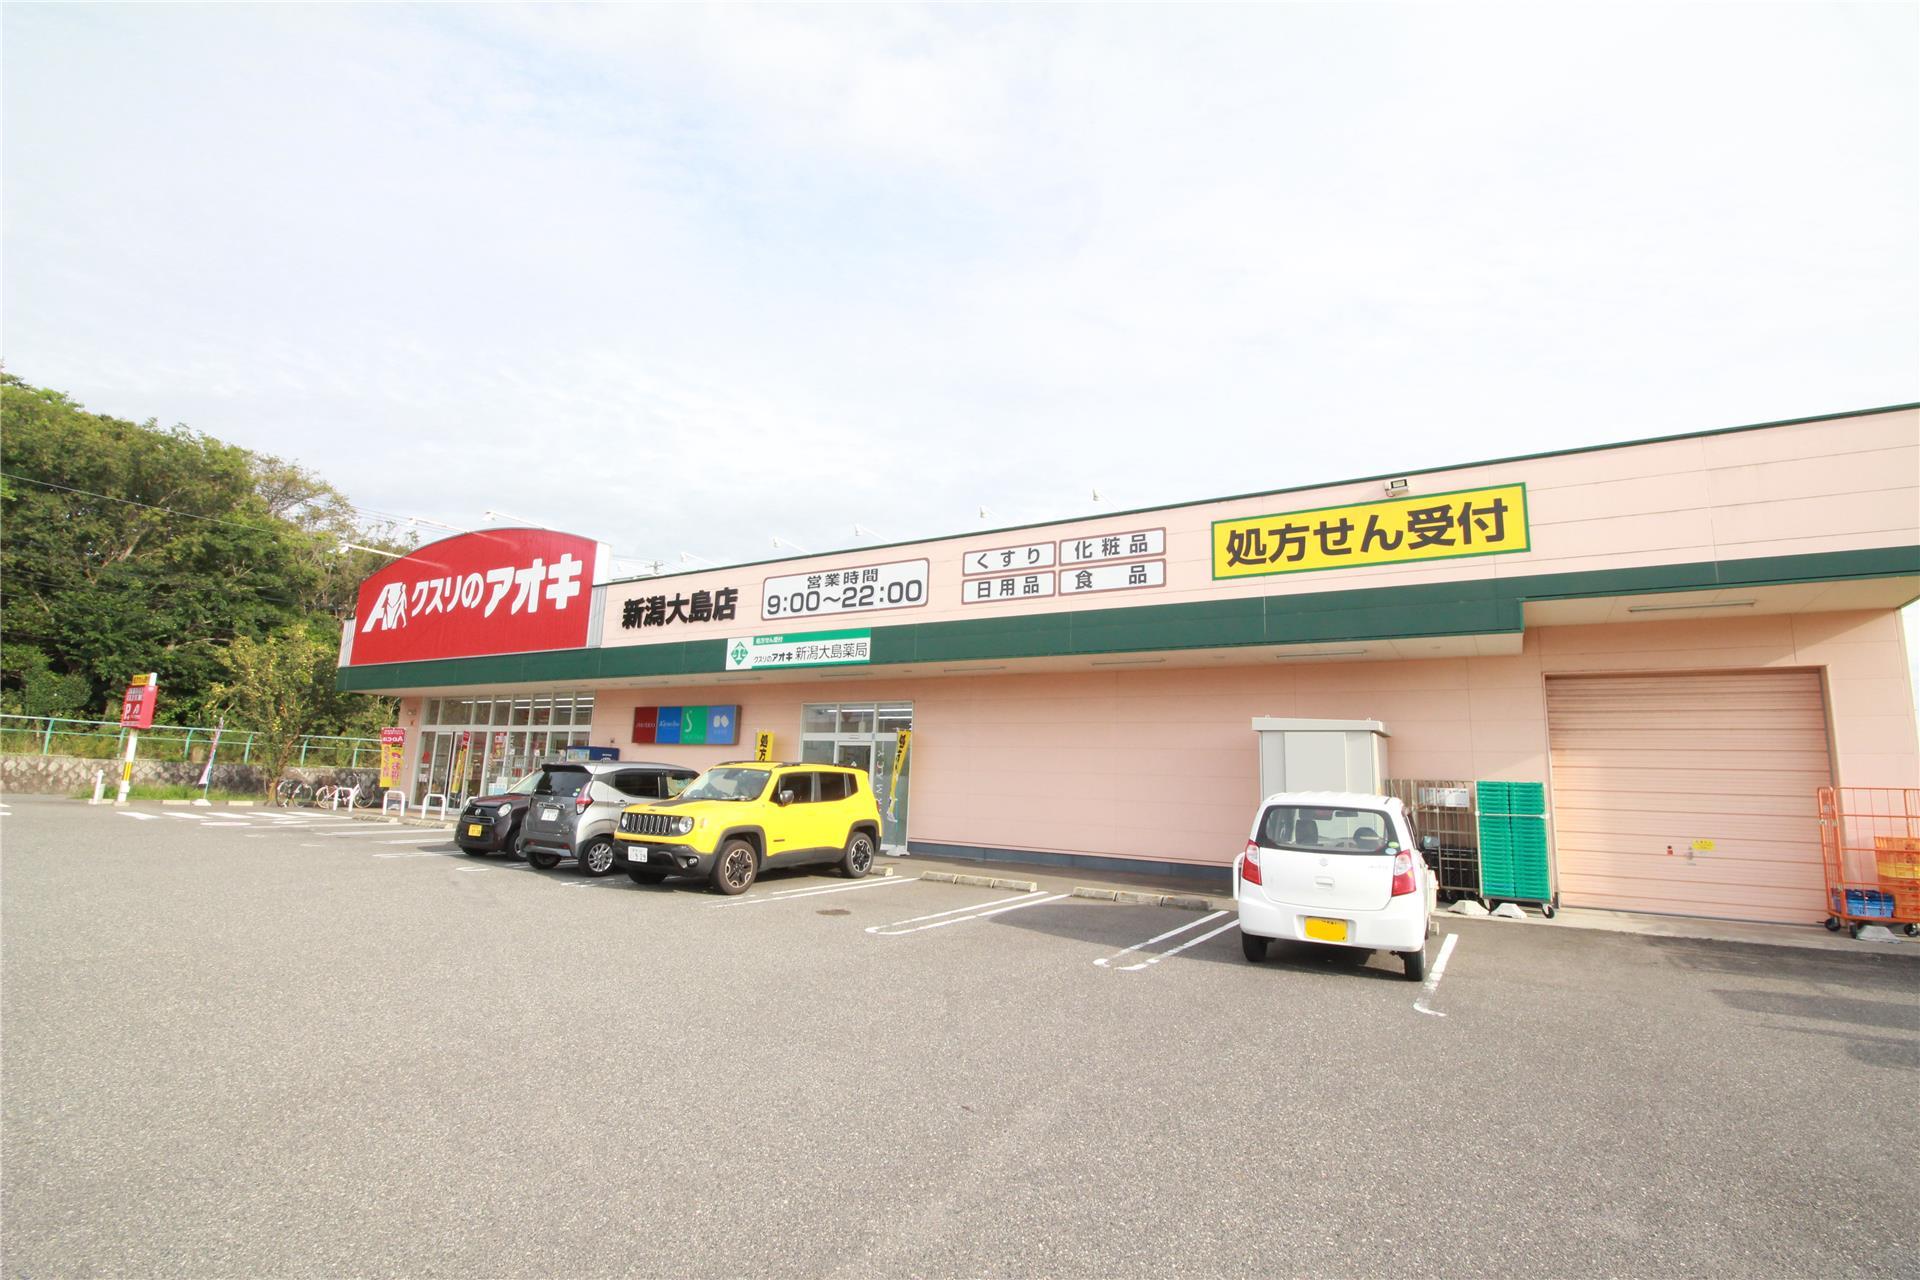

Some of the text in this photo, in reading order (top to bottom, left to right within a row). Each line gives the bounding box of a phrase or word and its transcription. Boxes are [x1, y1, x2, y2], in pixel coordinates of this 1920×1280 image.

[1226, 498, 1509, 567] 処方せん受付
[977, 548, 1040, 569] くすり
[1075, 534, 1148, 560] 化粧品
[411, 553, 583, 618] クスリのアオキ
[807, 568, 879, 589] 営業時間
[977, 576, 1039, 599] 日用品
[622, 587, 739, 630] 新潟大島店
[753, 642, 867, 664] クスリのアオキ 新潟大島薬局
